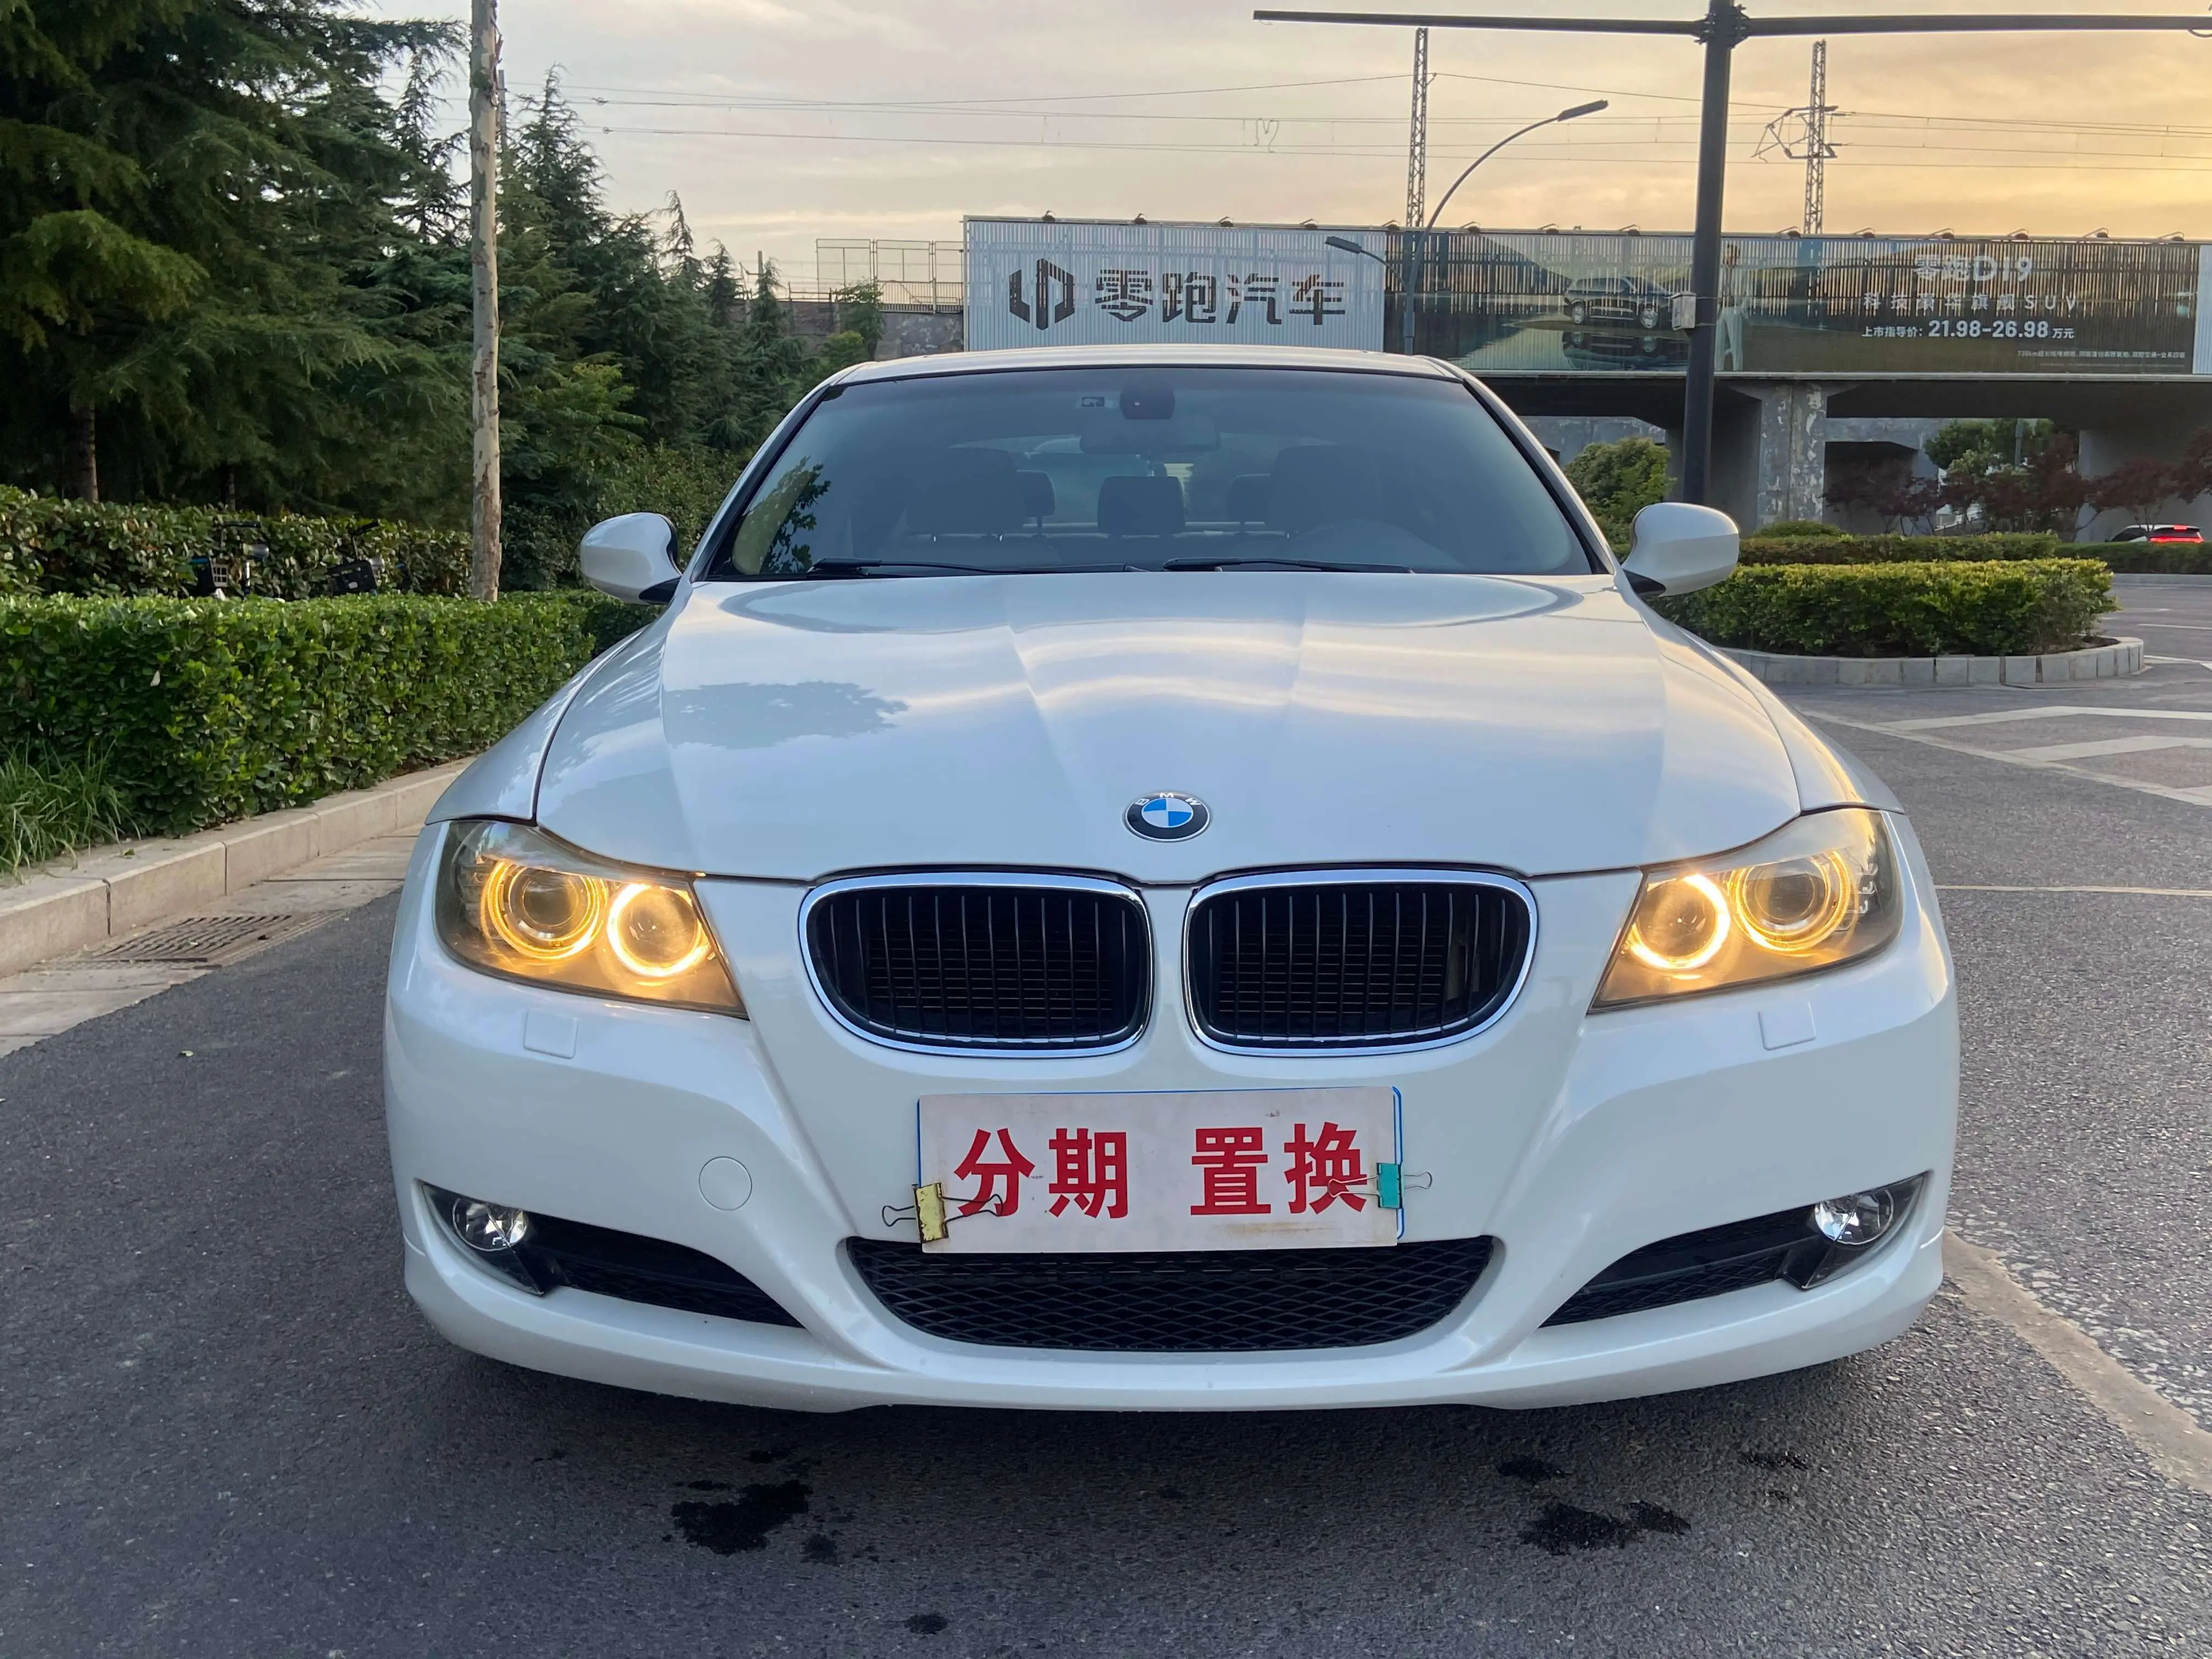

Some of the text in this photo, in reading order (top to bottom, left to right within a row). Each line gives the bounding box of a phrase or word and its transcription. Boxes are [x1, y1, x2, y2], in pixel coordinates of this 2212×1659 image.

[1094, 268, 1346, 326] 零跑汽车
[1928, 320, 2049, 338] 21.98-26.98
[2052, 328, 2075, 339] 万元
[1134, 792, 1201, 806] BMW
[953, 1122, 1368, 1218] 分期 置换
